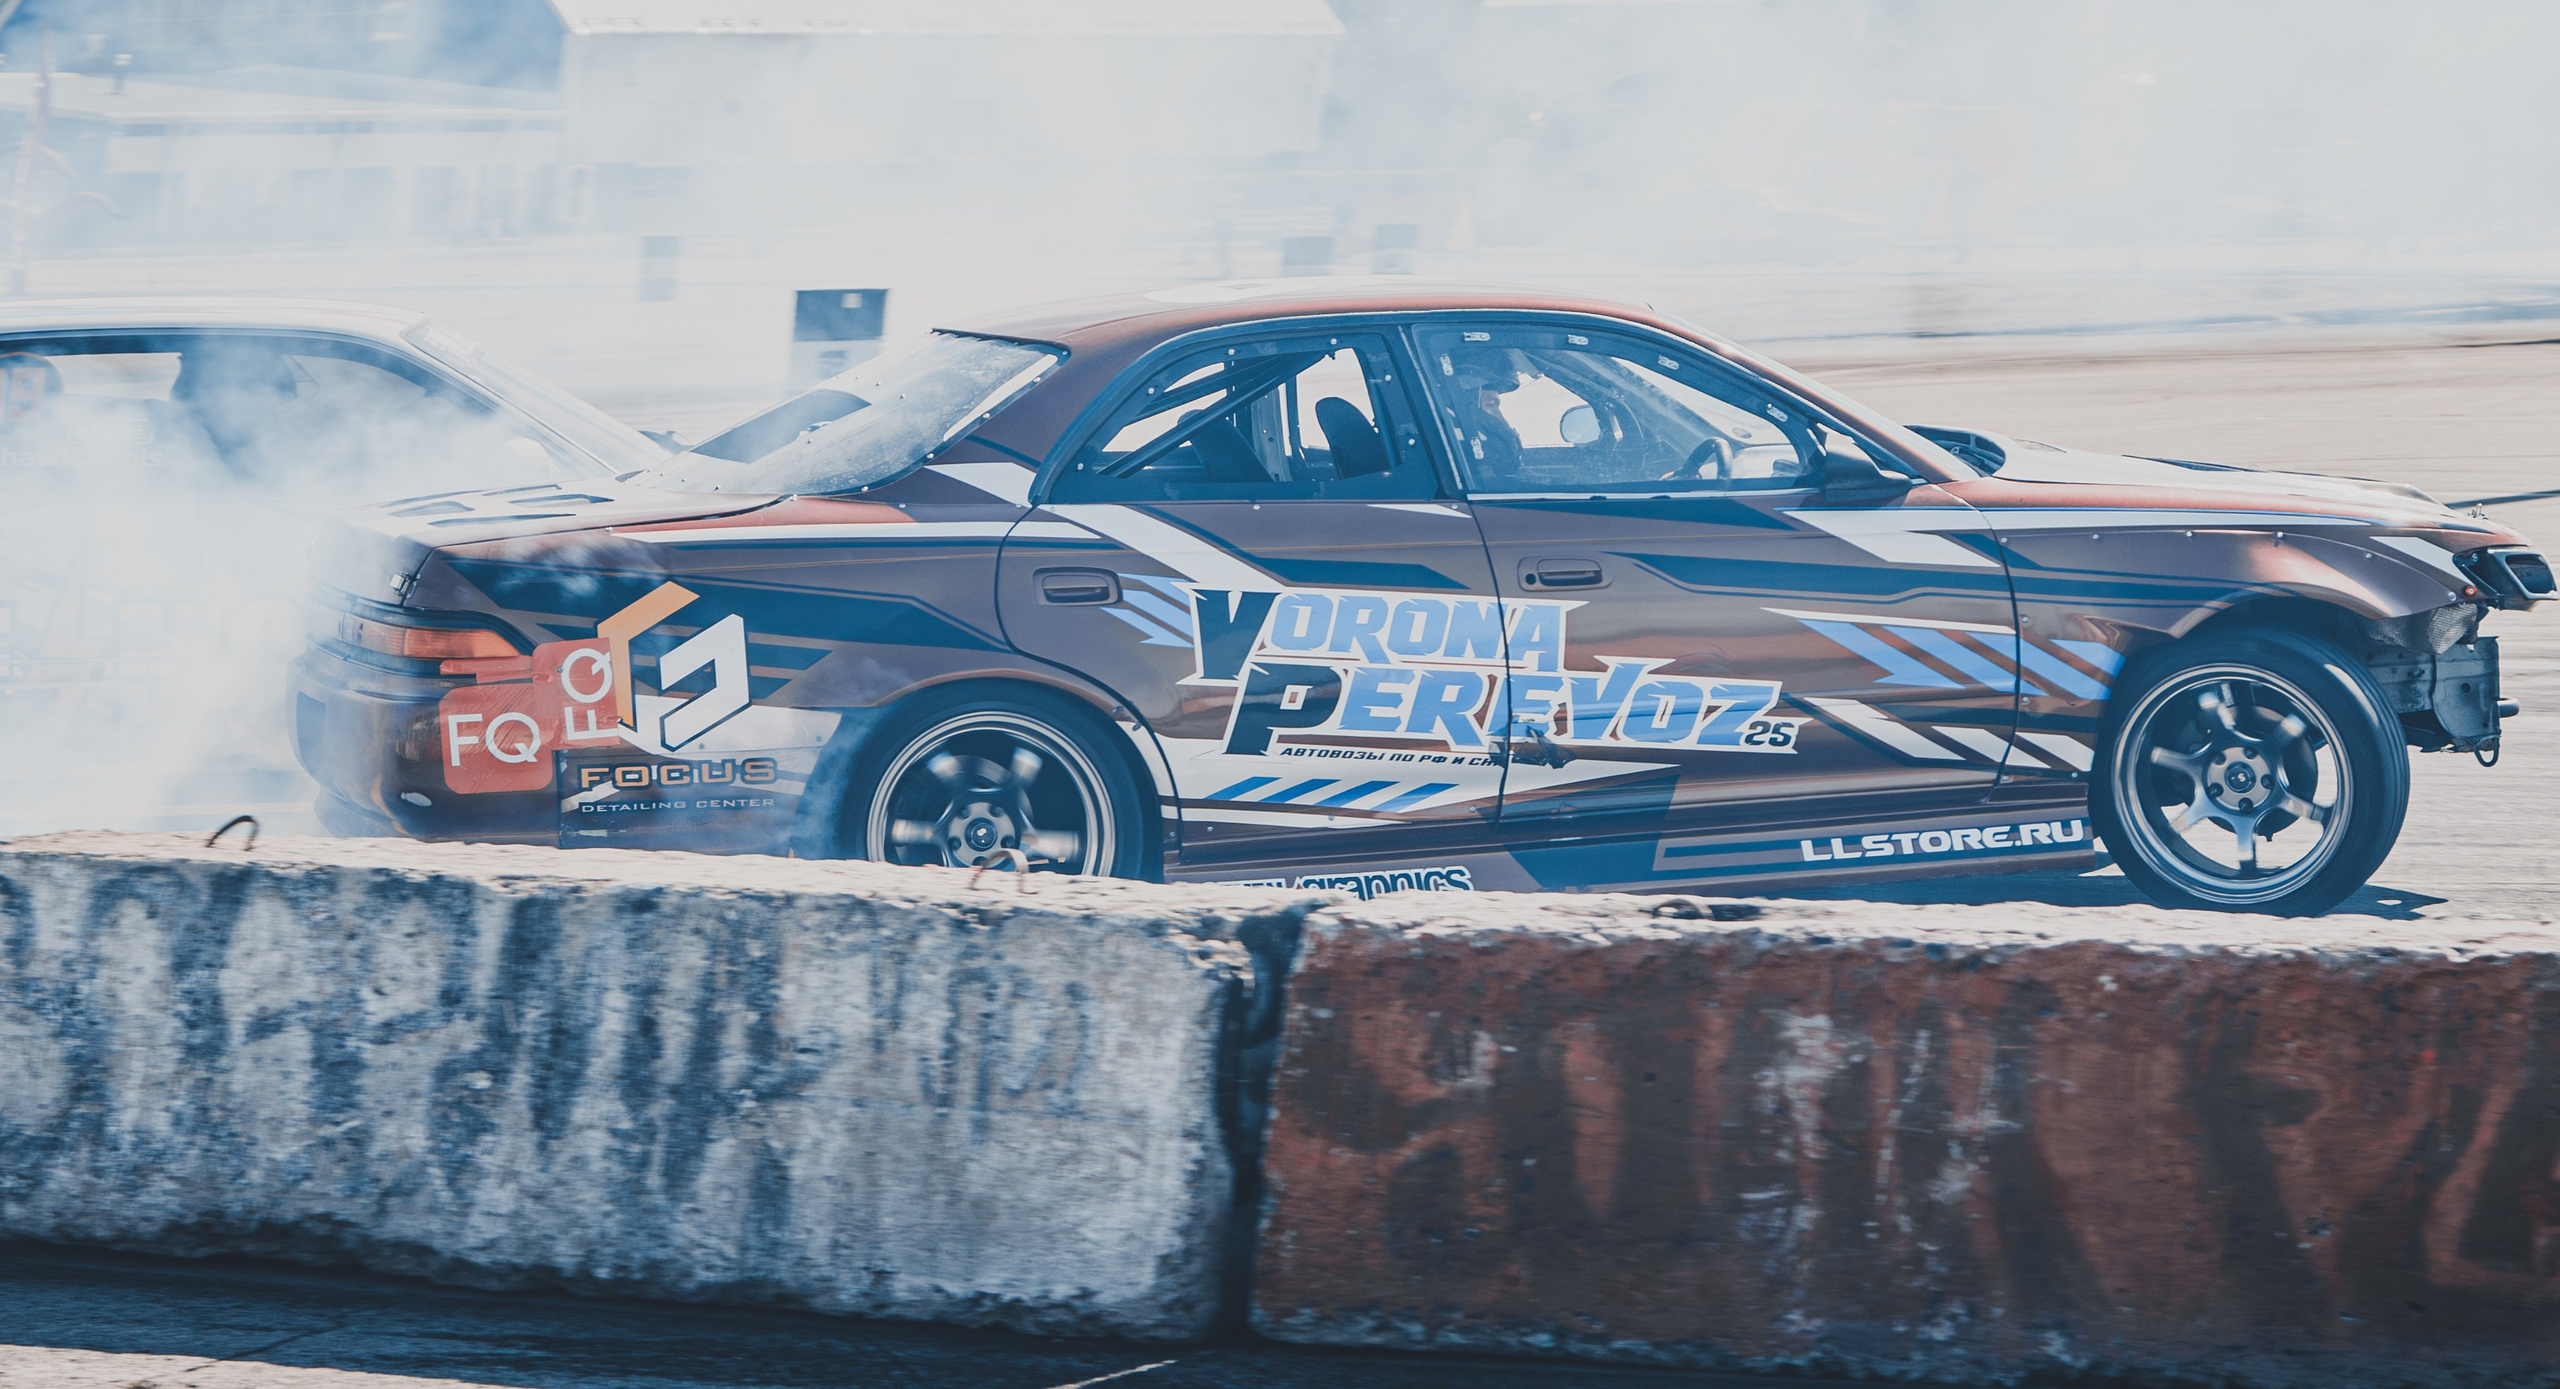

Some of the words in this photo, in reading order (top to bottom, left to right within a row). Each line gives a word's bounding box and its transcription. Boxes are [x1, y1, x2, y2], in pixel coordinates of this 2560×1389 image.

[1191, 588, 1562, 681] VORONA
[560, 648, 620, 740] FQ
[1222, 661, 1776, 756] PEREVOZ
[1744, 720, 1794, 748] 25
[448, 711, 542, 767] FQ
[1281, 747, 1386, 761] АВТОВОЗЫ
[1389, 753, 1414, 762] ПО
[1418, 754, 1449, 765] РФ
[1451, 756, 1466, 765] И
[580, 760, 776, 789] FOCUS
[582, 801, 687, 813] DETAILING
[695, 798, 775, 809] CENTER
[1800, 819, 2085, 862] LLSTORE.RU
